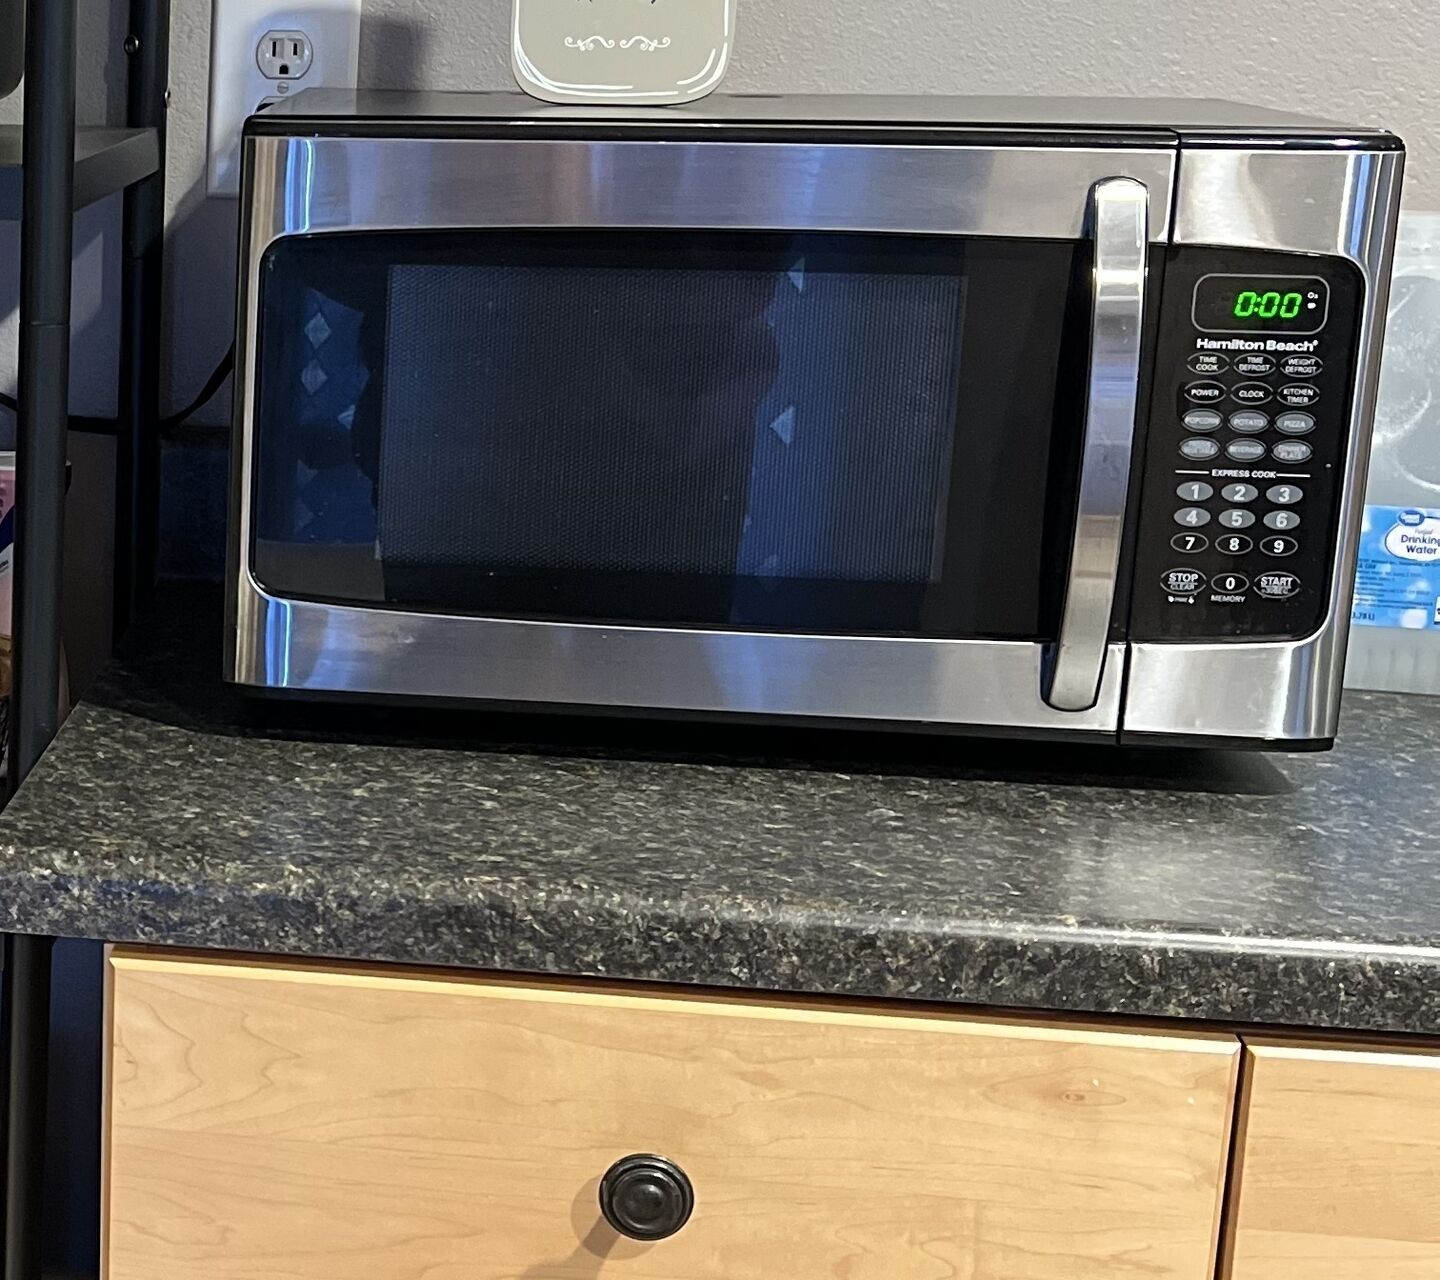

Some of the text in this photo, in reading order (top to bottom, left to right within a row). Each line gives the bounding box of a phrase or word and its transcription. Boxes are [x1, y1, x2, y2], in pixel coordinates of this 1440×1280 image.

[1234, 291, 1302, 318] 0:00
[1196, 338, 1264, 351] Hamilton
[1199, 356, 1218, 364] TIME
[1288, 358, 1316, 366] WEIGHT
[1196, 363, 1219, 371] COOK
[1191, 389, 1219, 397] POWER
[1238, 390, 1264, 398] CLOCK
[1283, 388, 1314, 396] KITCHEN
[1287, 396, 1309, 404] TIMER
[1284, 420, 1306, 428] PIZZA
[1212, 469, 1276, 479] EXPRESS COOK
[1191, 484, 1200, 499] 1
[1233, 486, 1246, 501] 2
[1278, 487, 1290, 502] 3
[1186, 510, 1198, 524] 4
[1231, 511, 1243, 526] 5
[1276, 513, 1288, 527] 6
[1185, 537, 1195, 549] 7
[1229, 538, 1240, 551] 8
[1273, 540, 1284, 553] 9
[1406, 545, 1437, 555] Water
[1169, 573, 1198, 582] STOP
[1260, 577, 1293, 586] START
[1225, 577, 1235, 589] 0
[1211, 595, 1246, 603] MEMORY
